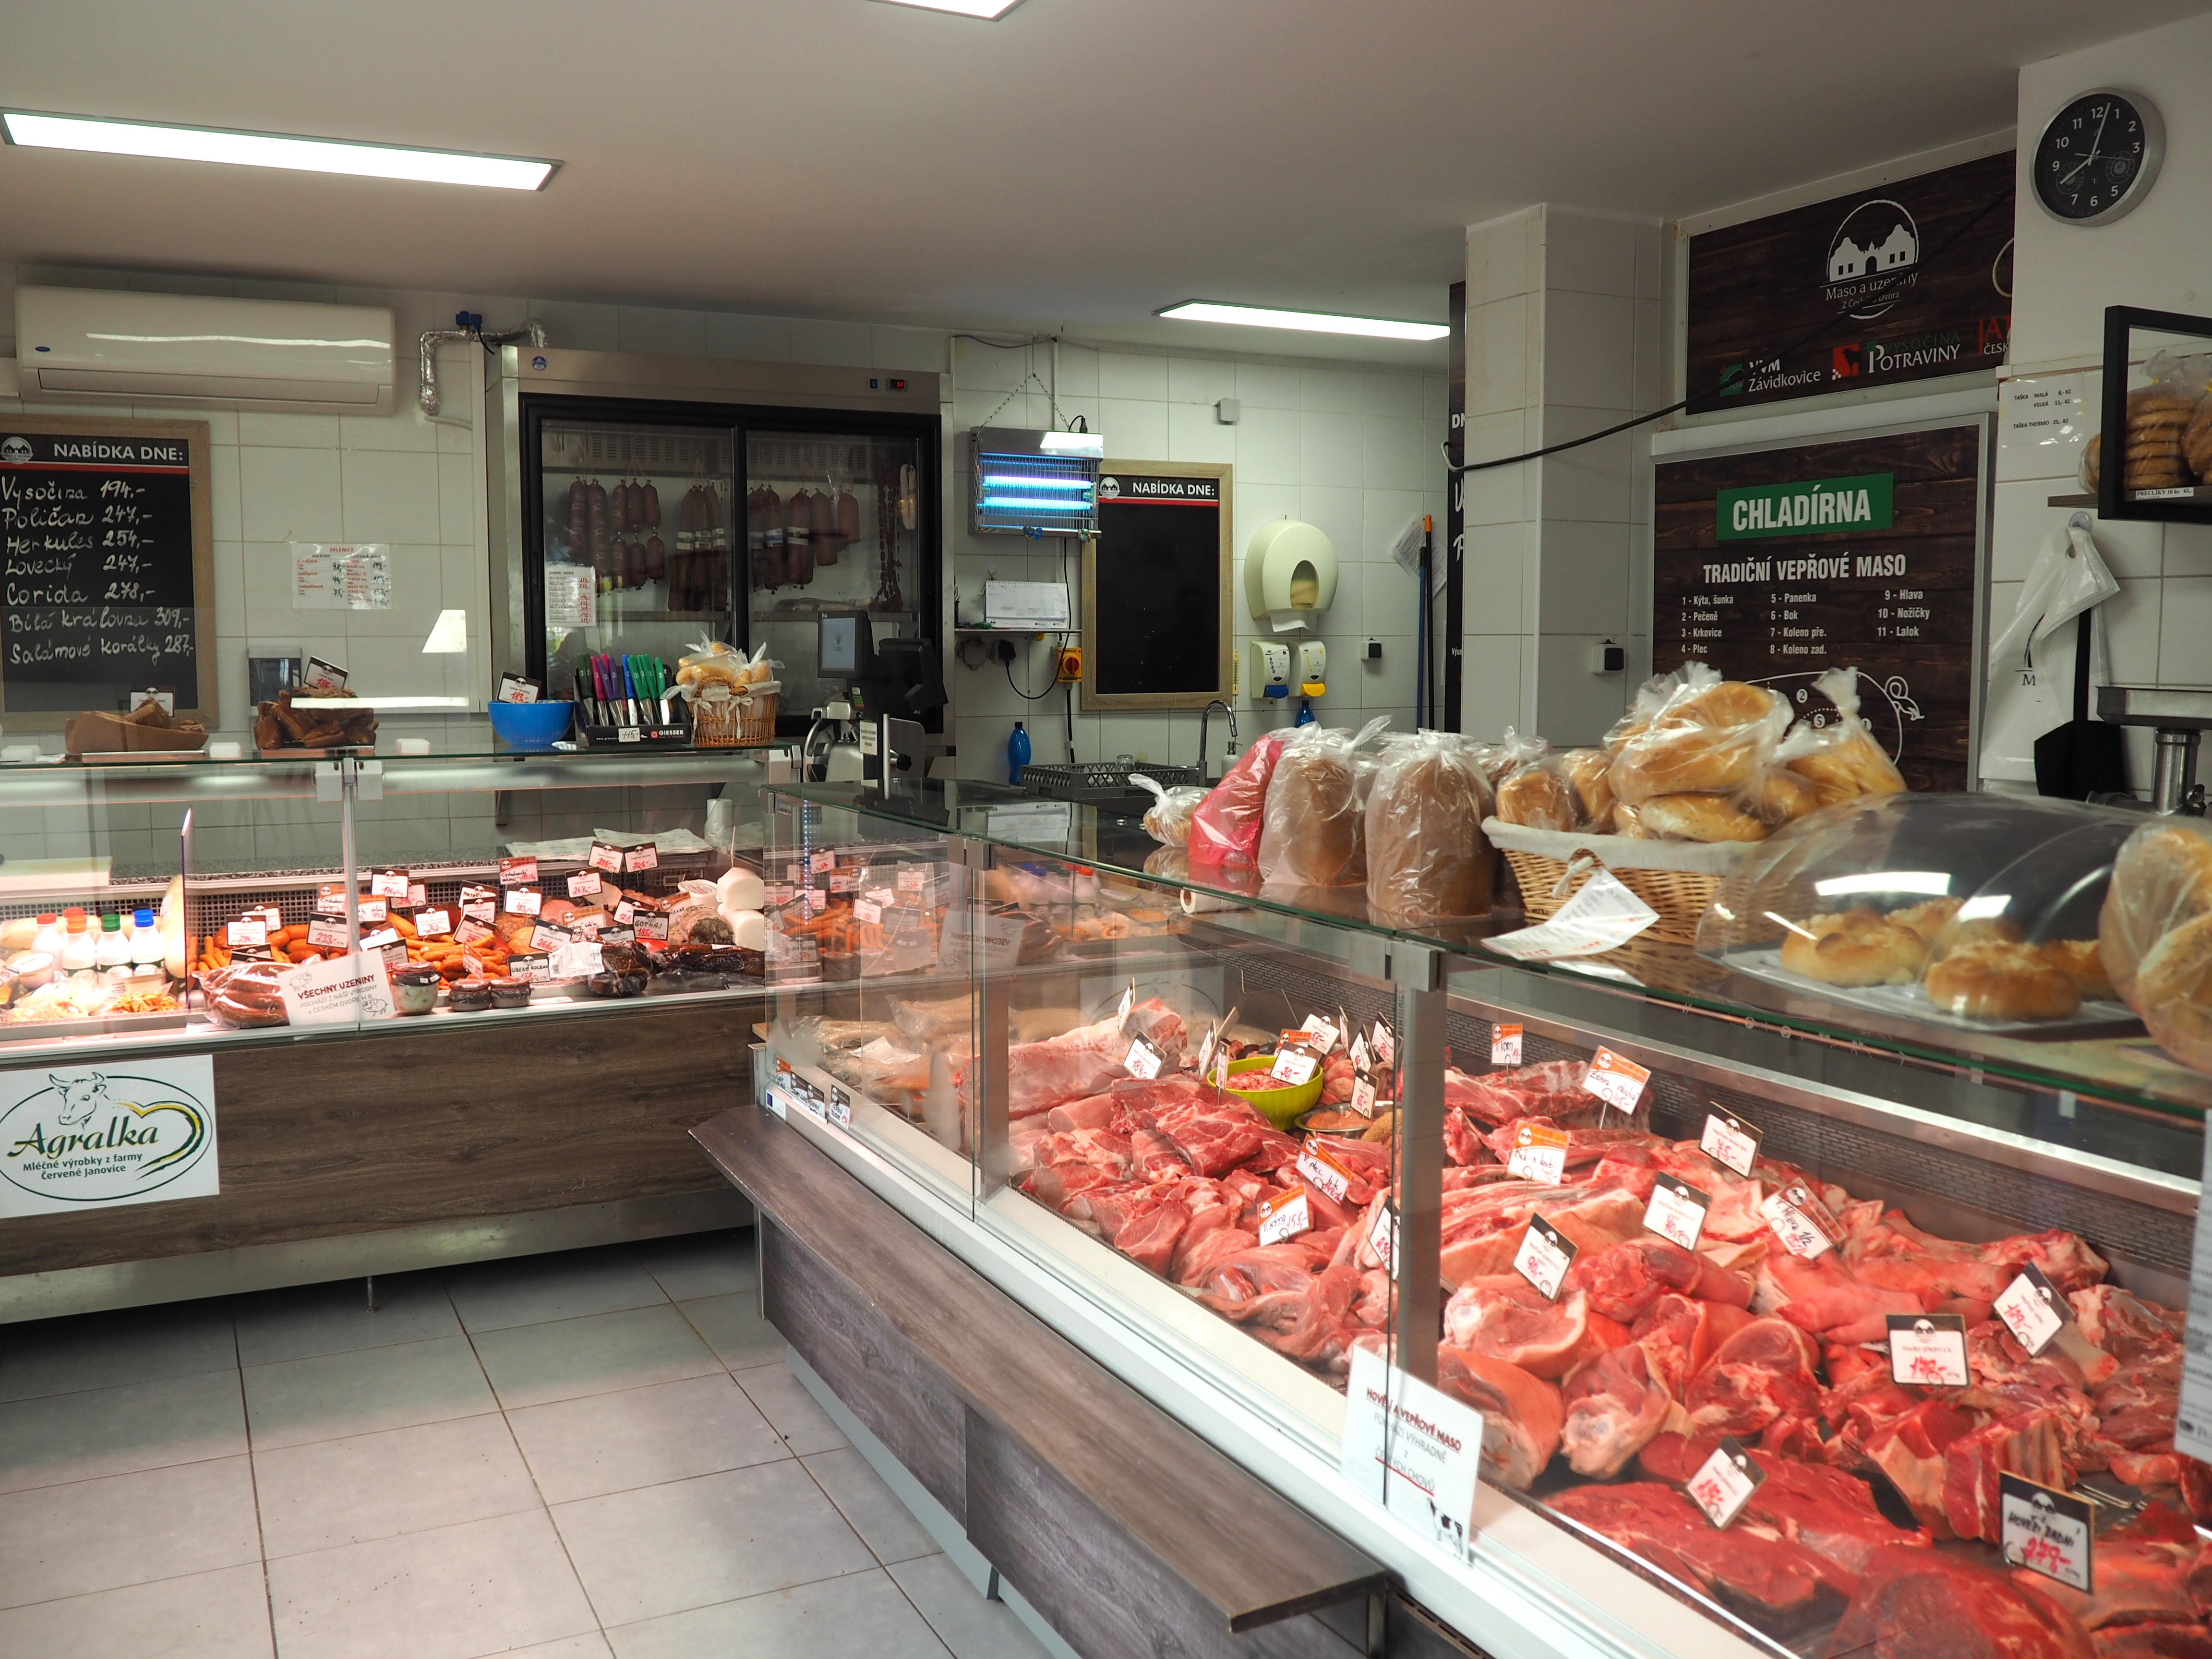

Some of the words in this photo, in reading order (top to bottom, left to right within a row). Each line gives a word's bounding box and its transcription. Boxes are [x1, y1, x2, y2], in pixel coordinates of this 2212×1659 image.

[2091, 107, 2104, 119] 12
[2115, 108, 2119, 119] 1
[2073, 118, 2082, 129] 11
[2128, 121, 2136, 132] 2
[2056, 137, 2069, 148] 10
[2133, 142, 2140, 153] 3
[2052, 161, 2060, 171] 9
[2111, 185, 2118, 196] 5
[2071, 194, 2078, 204] 7
[2090, 196, 2098, 206] 6
[1826, 286, 1856, 300] Maso
[1859, 284, 1866, 293] a
[1883, 330, 1960, 354] VYSOČINA
[1868, 344, 1960, 373] POTRAVINY
[1748, 370, 1821, 392] Závidkovice
[54, 441, 136, 459] NABÍDKA
[140, 446, 183, 461] DNE:
[1, 477, 87, 508] Vysočina
[1133, 480, 1184, 494] NABÍDKA
[1187, 484, 1215, 496] DNE:
[1732, 484, 1871, 531] CHLADÍRNA
[102, 505, 152, 526] 247,-
[5, 553, 76, 579] Lovecký
[103, 554, 152, 573] 247,-
[1703, 555, 1772, 584] TRADIČNÍ
[1777, 551, 1850, 581] VEPŘOVÉ
[1856, 554, 1906, 577] MASO
[7, 583, 88, 606] Corida
[104, 582, 155, 600] 278,-
[1682, 596, 1686, 605] 1
[1694, 595, 1711, 607] Kýta,
[1713, 594, 1733, 604] šunka
[1771, 594, 1776, 603] 5
[1784, 592, 1816, 603] Panenka
[1885, 590, 1890, 600] 9
[1899, 589, 1923, 600] Hlava
[1682, 612, 1686, 621] 2
[1694, 611, 1718, 621] Pečeně
[1771, 611, 1776, 620] 6
[1784, 610, 1798, 620] Bok
[1878, 608, 1888, 618] 10
[1898, 607, 1930, 620] Nožičky
[1682, 628, 1686, 637] 3
[1693, 627, 1722, 637] Krkovice
[1770, 627, 1775, 637] 7
[1783, 627, 1809, 637] Koleno
[1811, 626, 1827, 639] pře.
[1877, 626, 1886, 637] 11
[1896, 626, 1919, 636] Lalok
[10, 636, 90, 664] Salámové
[101, 635, 160, 666] korálky
[1681, 644, 1686, 653] 4
[1693, 644, 1707, 653] Plec
[1770, 645, 1775, 654] 8
[1783, 644, 1808, 654] Koleno
[1811, 644, 1827, 654] zad.
[635, 920, 662, 929] GOTHAJ
[298, 984, 338, 999] VŠECHNY
[339, 974, 374, 990] UZENINY
[300, 997, 327, 1008] POCHÁZÍ
[333, 991, 349, 1000] NAŠÍ
[349, 984, 377, 996] VÝROBNY
[313, 1002, 339, 1013] ČESKÉM
[340, 997, 360, 1006] DVOŘE
[7, 1116, 159, 1160] Agralka
[23, 1160, 59, 1172] Mléčné
[62, 1156, 102, 1168] výrobky
[114, 1154, 142, 1163] farmy
[41, 1168, 81, 1180] Červené
[84, 1165, 126, 1178] Janovice
[1394, 1404, 1399, 1415] A
[1399, 1407, 1437, 1436] VEPŘOVÉ
[1437, 1430, 1462, 1451] MASO
[1407, 1430, 1447, 1463] VÝHRADNĚ
[1376, 1445, 1406, 1476] ČEKÝCH
[1408, 1469, 1434, 1492] CHOVŮ
